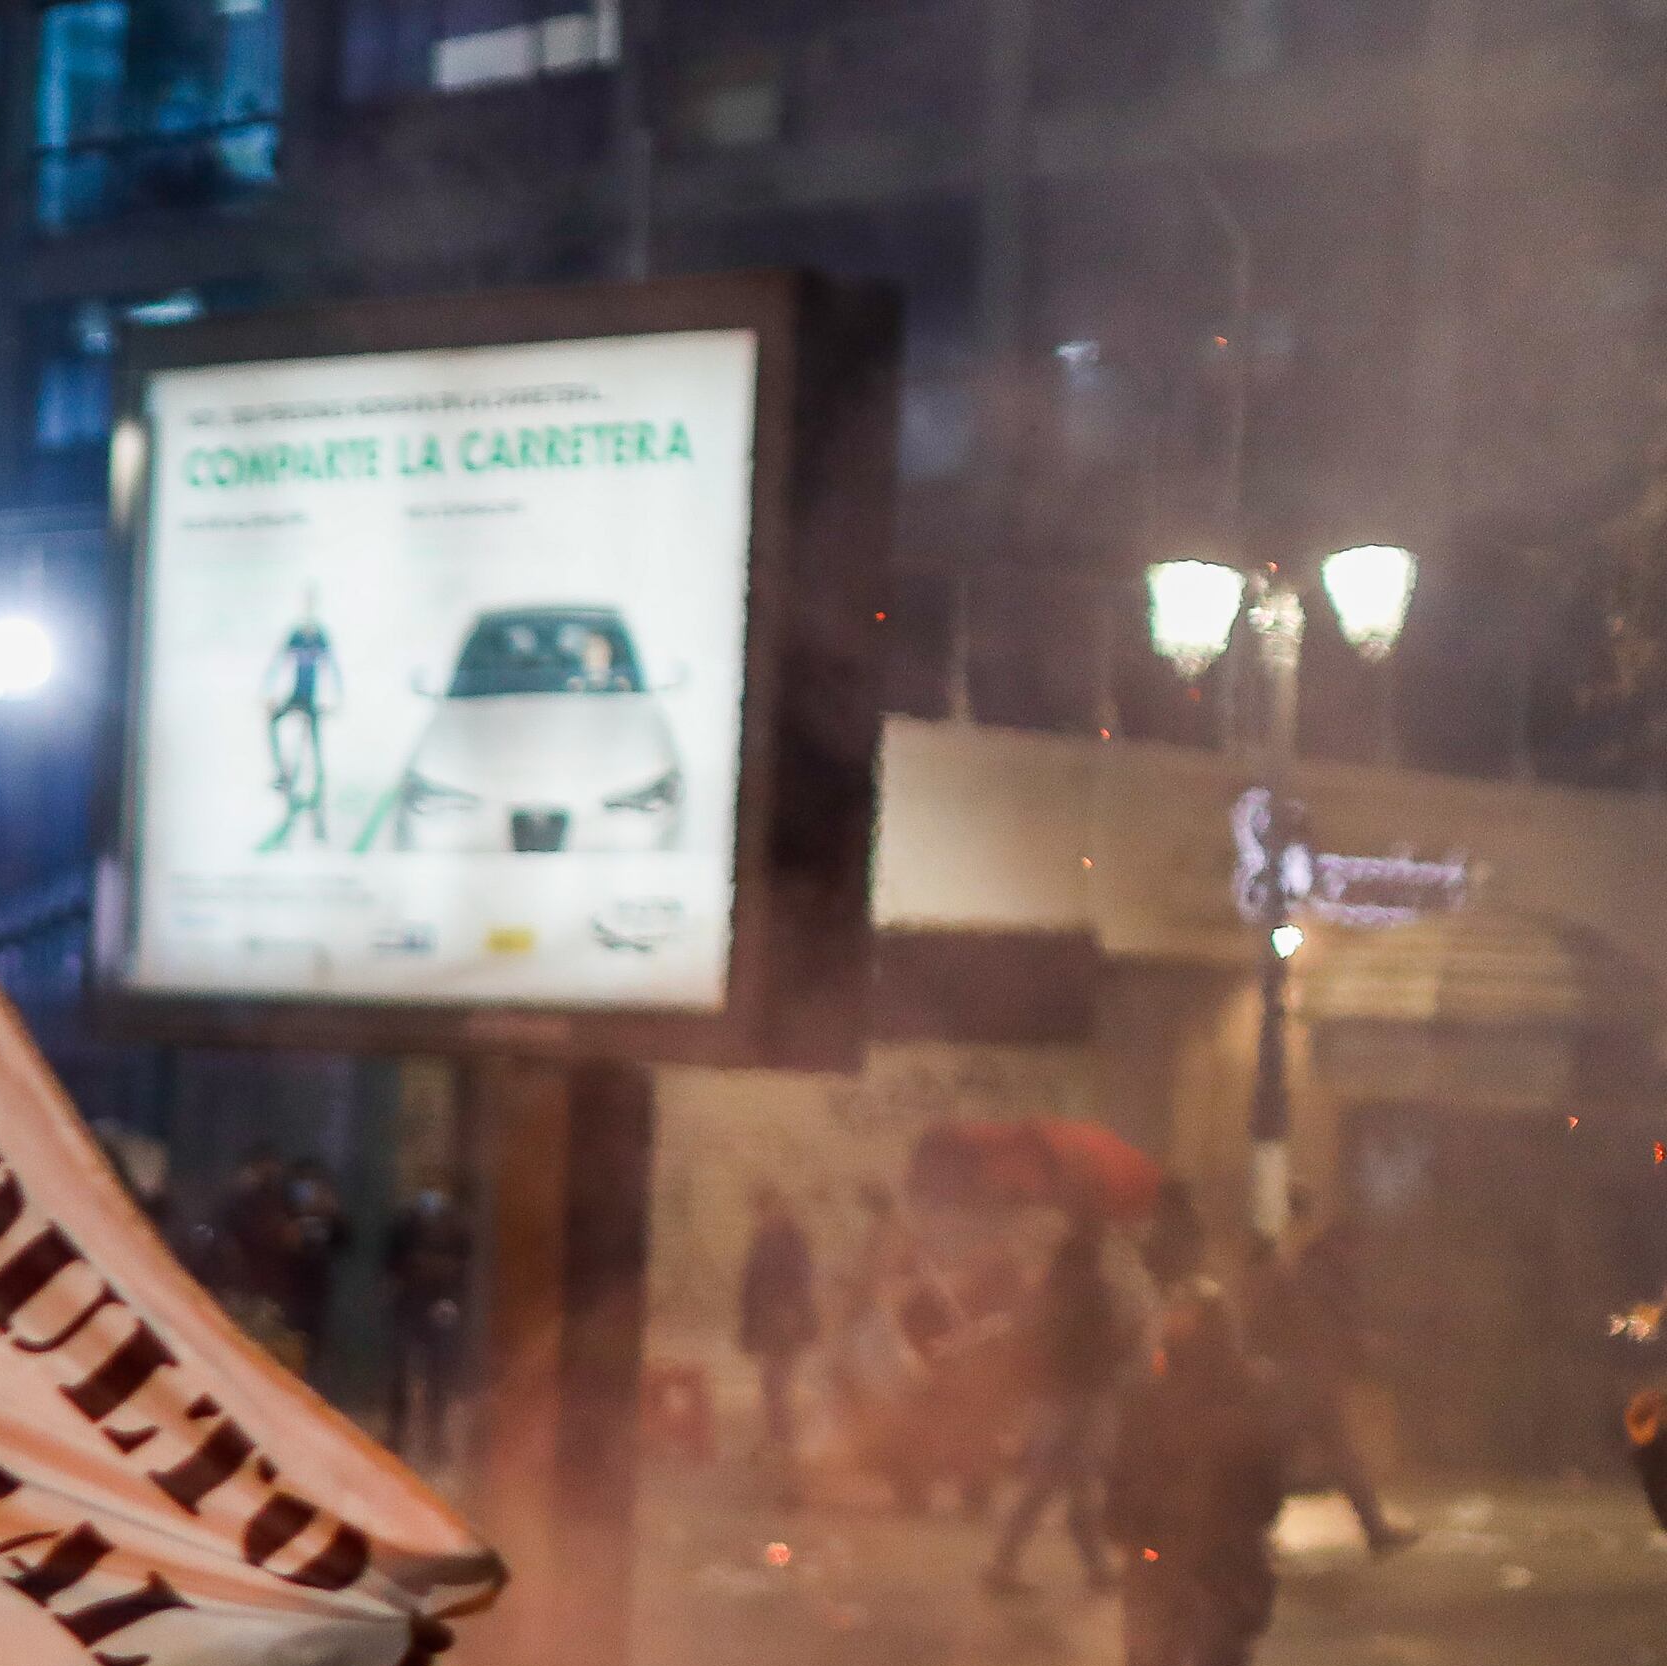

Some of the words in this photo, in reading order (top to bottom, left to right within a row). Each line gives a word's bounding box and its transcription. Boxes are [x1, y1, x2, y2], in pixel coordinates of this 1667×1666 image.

[183, 437, 380, 488] COMPARTE
[399, 434, 444, 475] LA
[463, 421, 693, 472] CARRETERA
